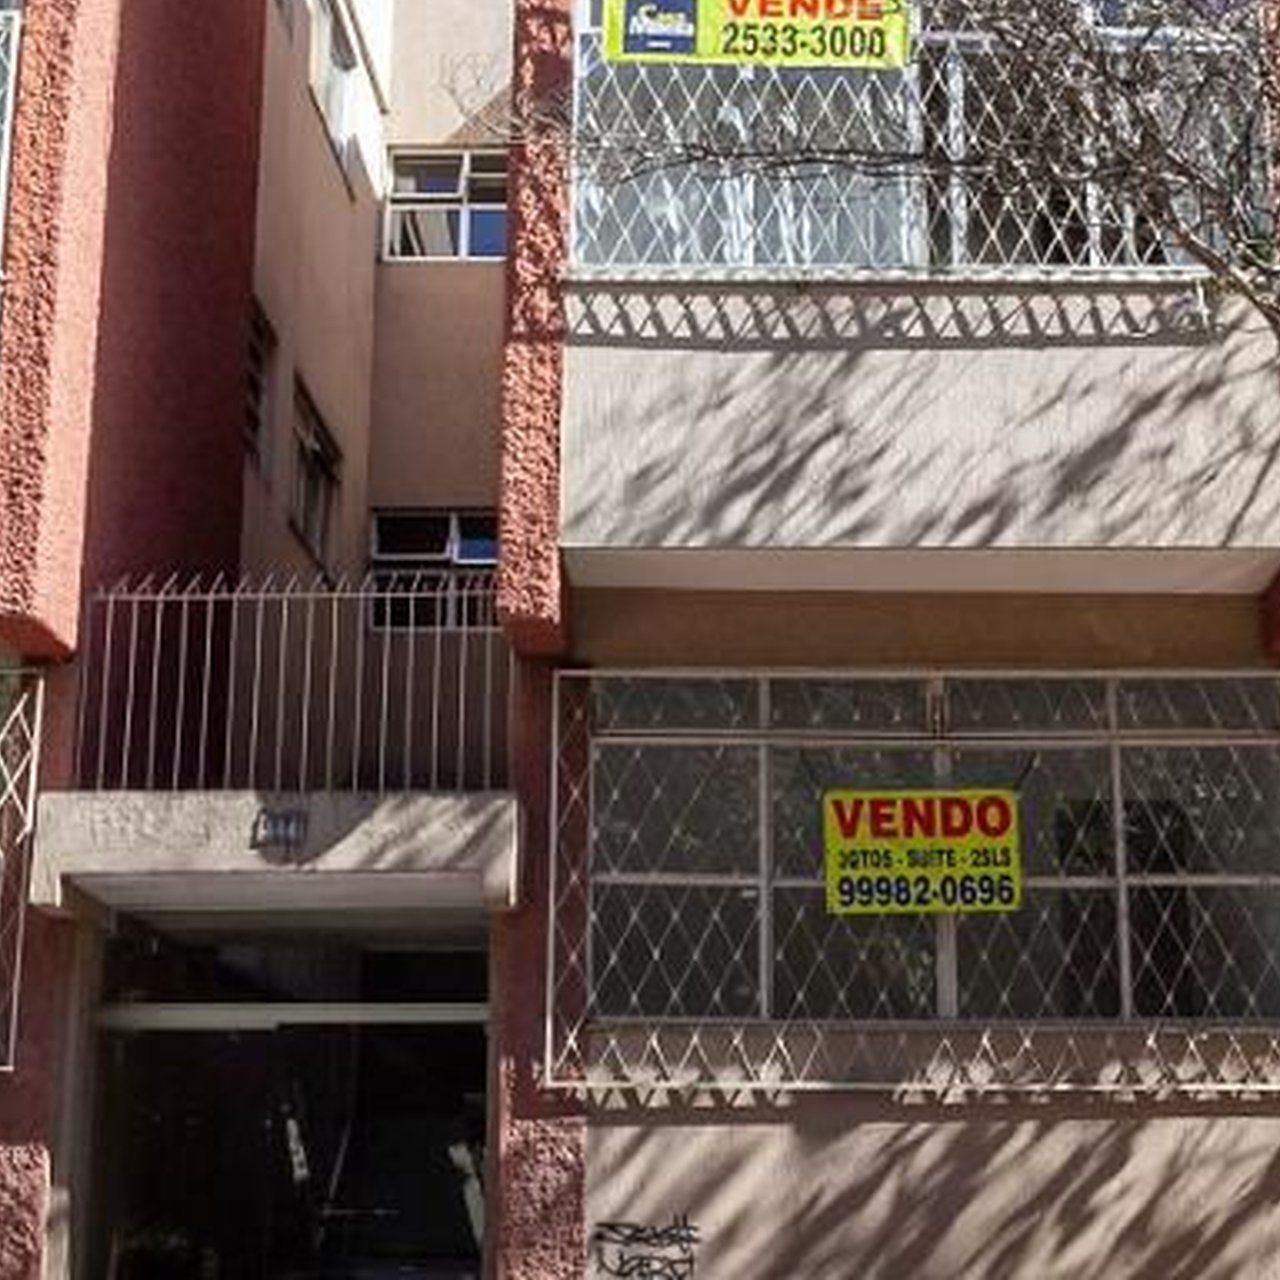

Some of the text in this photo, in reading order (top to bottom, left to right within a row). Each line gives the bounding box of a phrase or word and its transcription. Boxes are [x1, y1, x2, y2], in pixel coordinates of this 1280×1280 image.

[721, 24, 887, 59] 2533-3000
[831, 797, 1013, 839] VENDO
[837, 875, 1015, 906] 99982-0696
